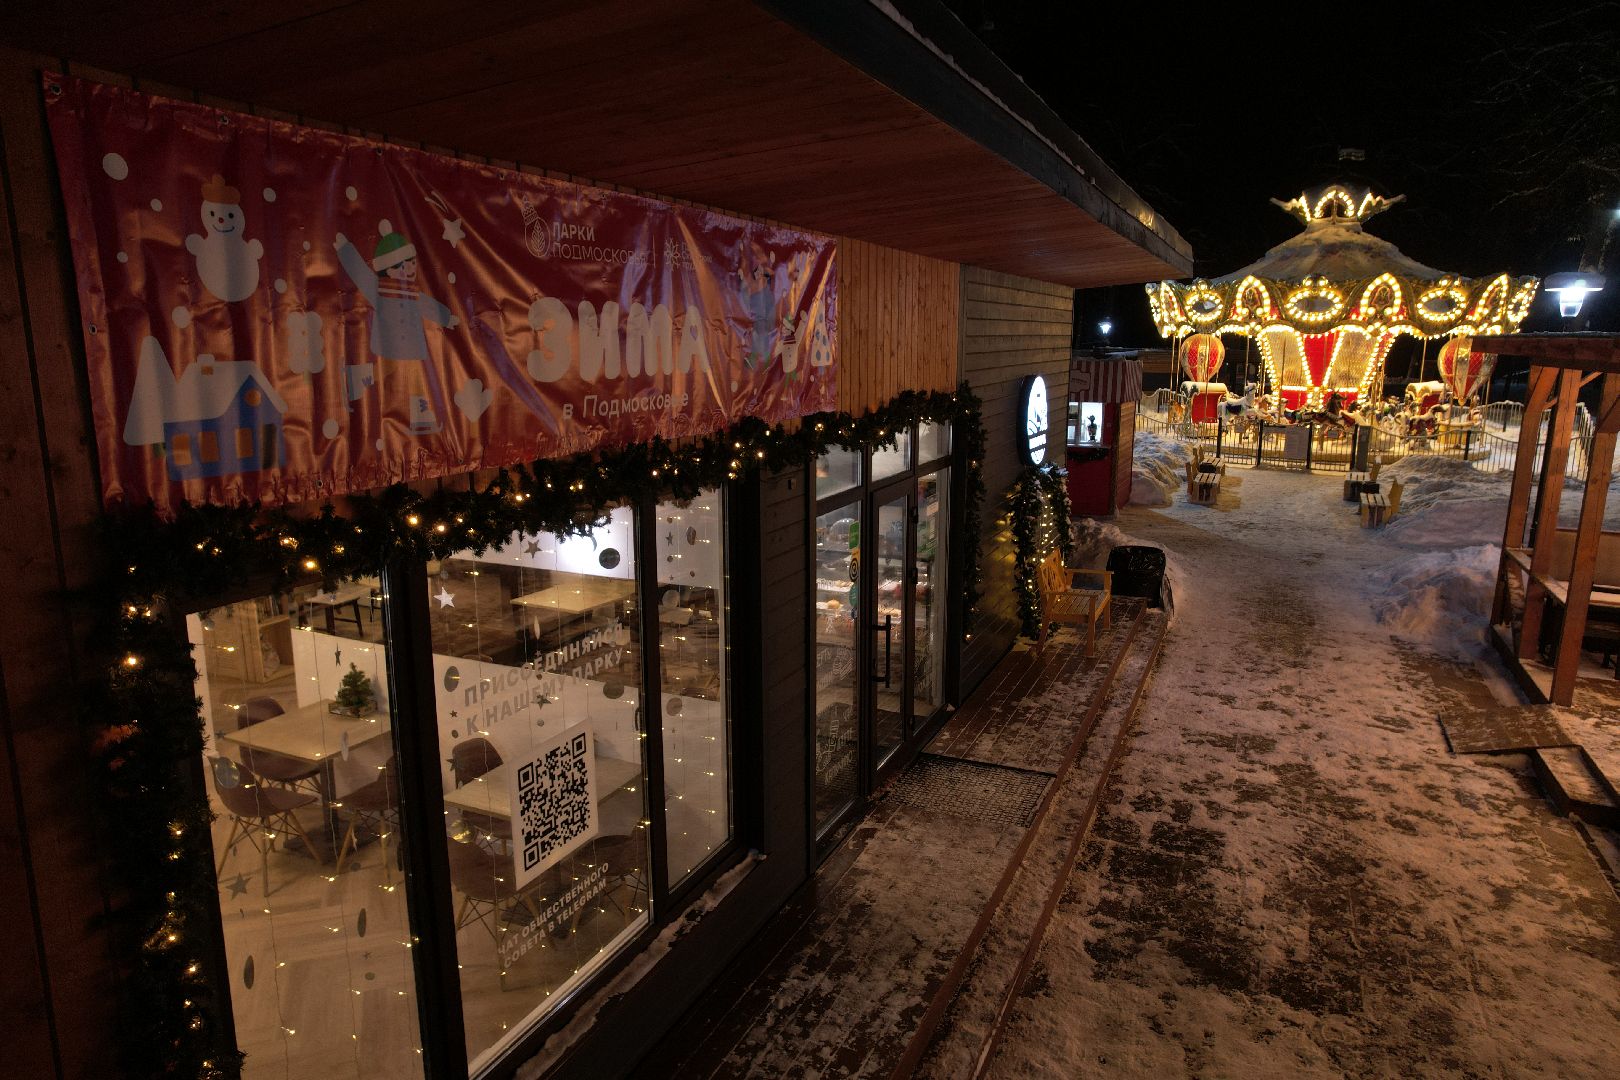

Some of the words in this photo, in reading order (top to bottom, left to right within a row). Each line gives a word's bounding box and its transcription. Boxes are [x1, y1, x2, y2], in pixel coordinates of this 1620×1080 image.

[552, 222, 595, 242] ПАРКИ
[527, 296, 710, 382] ЗИМА
[562, 402, 574, 420] в
[583, 393, 689, 419] Подмоскове
[466, 716, 479, 736] К
[486, 674, 566, 729] НАШЕМУ
[573, 648, 624, 685] ПАРКУ
[498, 934, 519, 955] ЧАТ
[521, 862, 609, 938] ОБЩЕСТВЕННОГО
[503, 929, 547, 968] СОВЕТА
[548, 922, 555, 932] В
[557, 879, 607, 925] TELEGRAM
